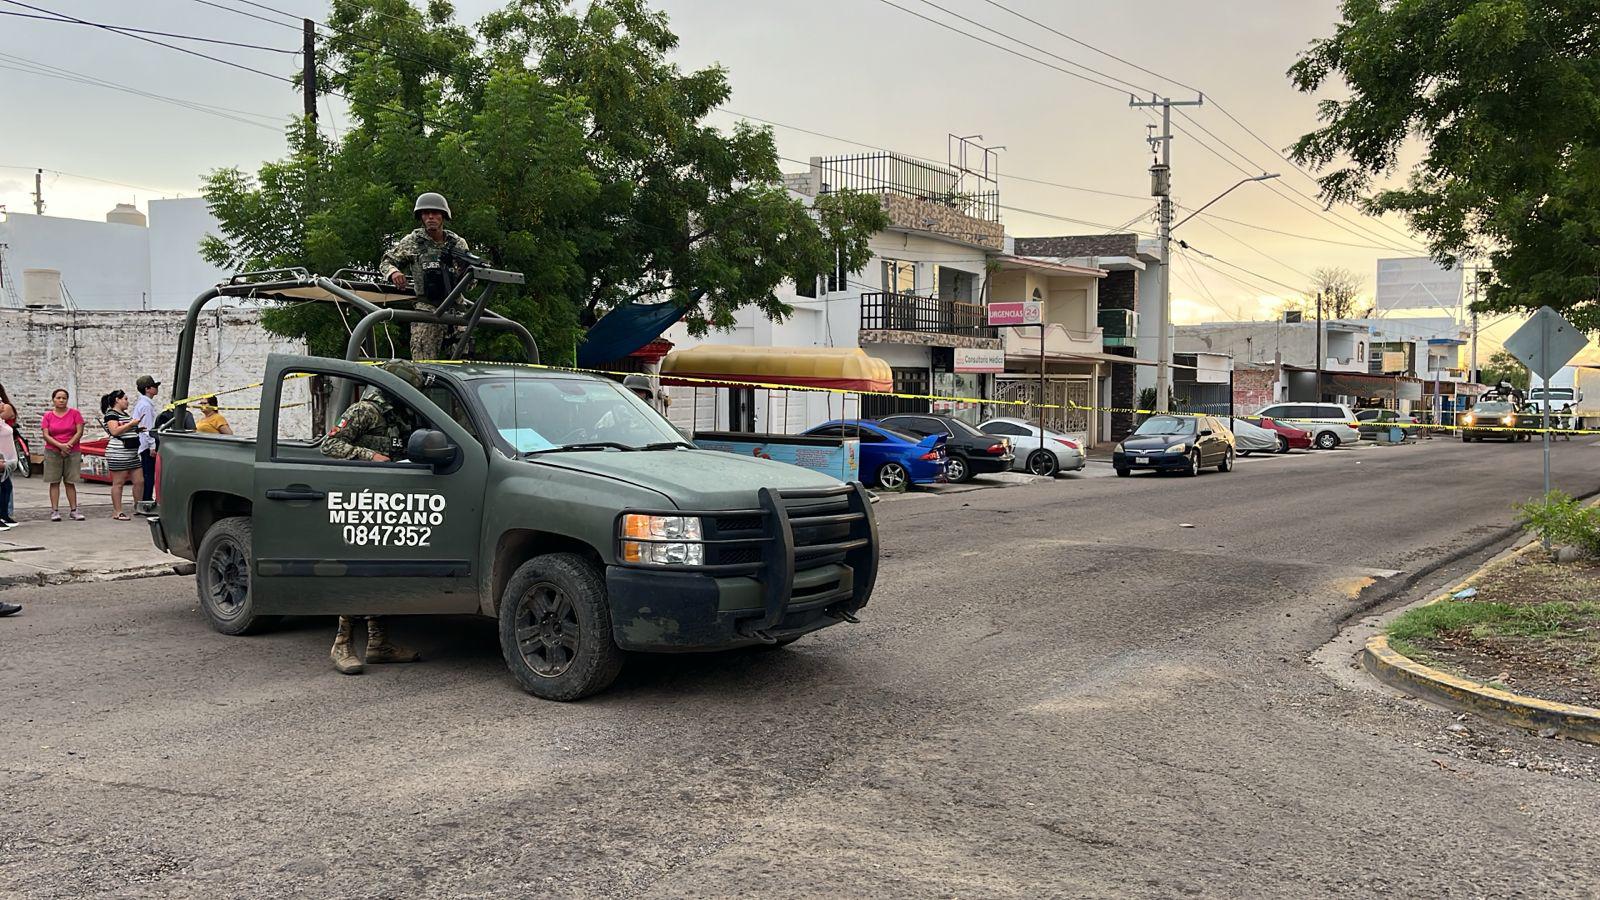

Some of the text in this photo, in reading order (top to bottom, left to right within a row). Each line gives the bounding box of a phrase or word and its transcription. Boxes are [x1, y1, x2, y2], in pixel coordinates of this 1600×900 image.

[989, 310, 1023, 319] URGENCIAS
[1025, 308, 1039, 318] 24
[327, 488, 446, 512] EJÉRCITO
[329, 510, 444, 526] MEXICANO
[343, 525, 432, 547] 0847352
